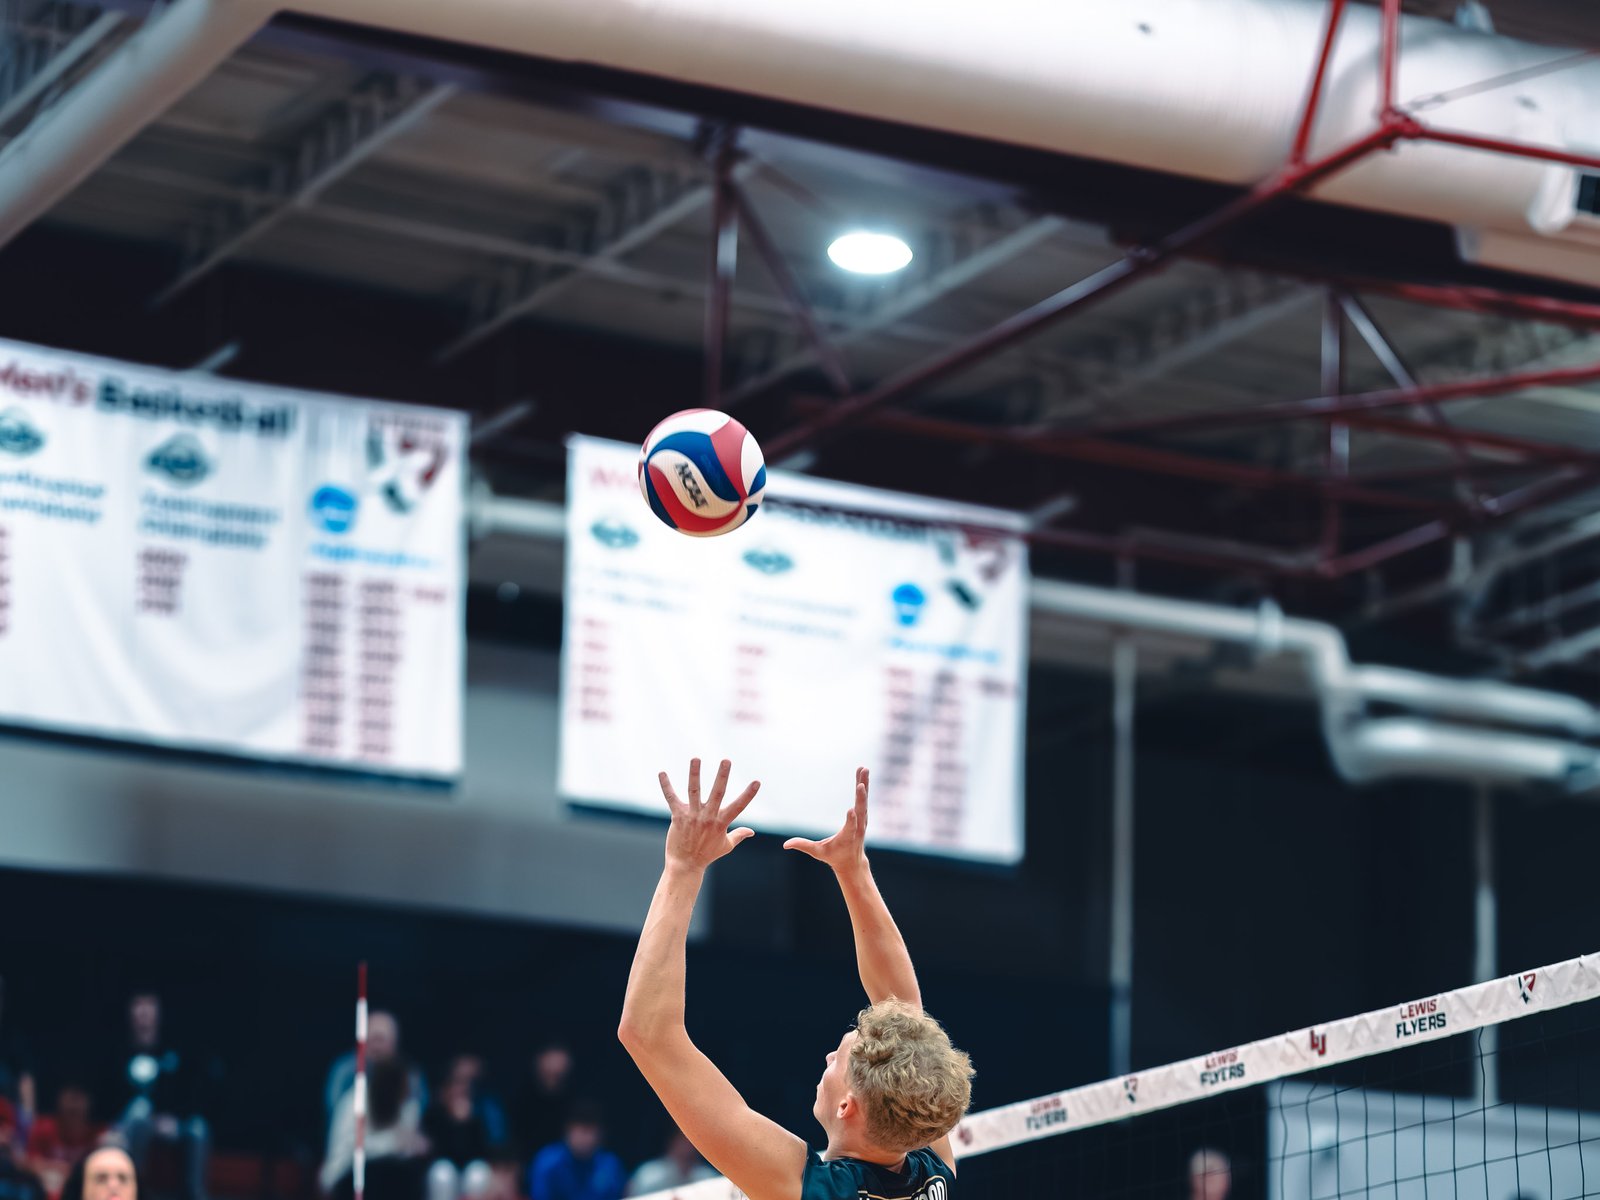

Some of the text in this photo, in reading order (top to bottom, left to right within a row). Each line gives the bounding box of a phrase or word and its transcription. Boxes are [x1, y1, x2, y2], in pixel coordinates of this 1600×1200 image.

[675, 461, 709, 509] NCAA
[1400, 999, 1437, 1020] LEWIS
[1396, 1012, 1446, 1039] FLYERS
[1200, 1062, 1245, 1085] FLYERS
